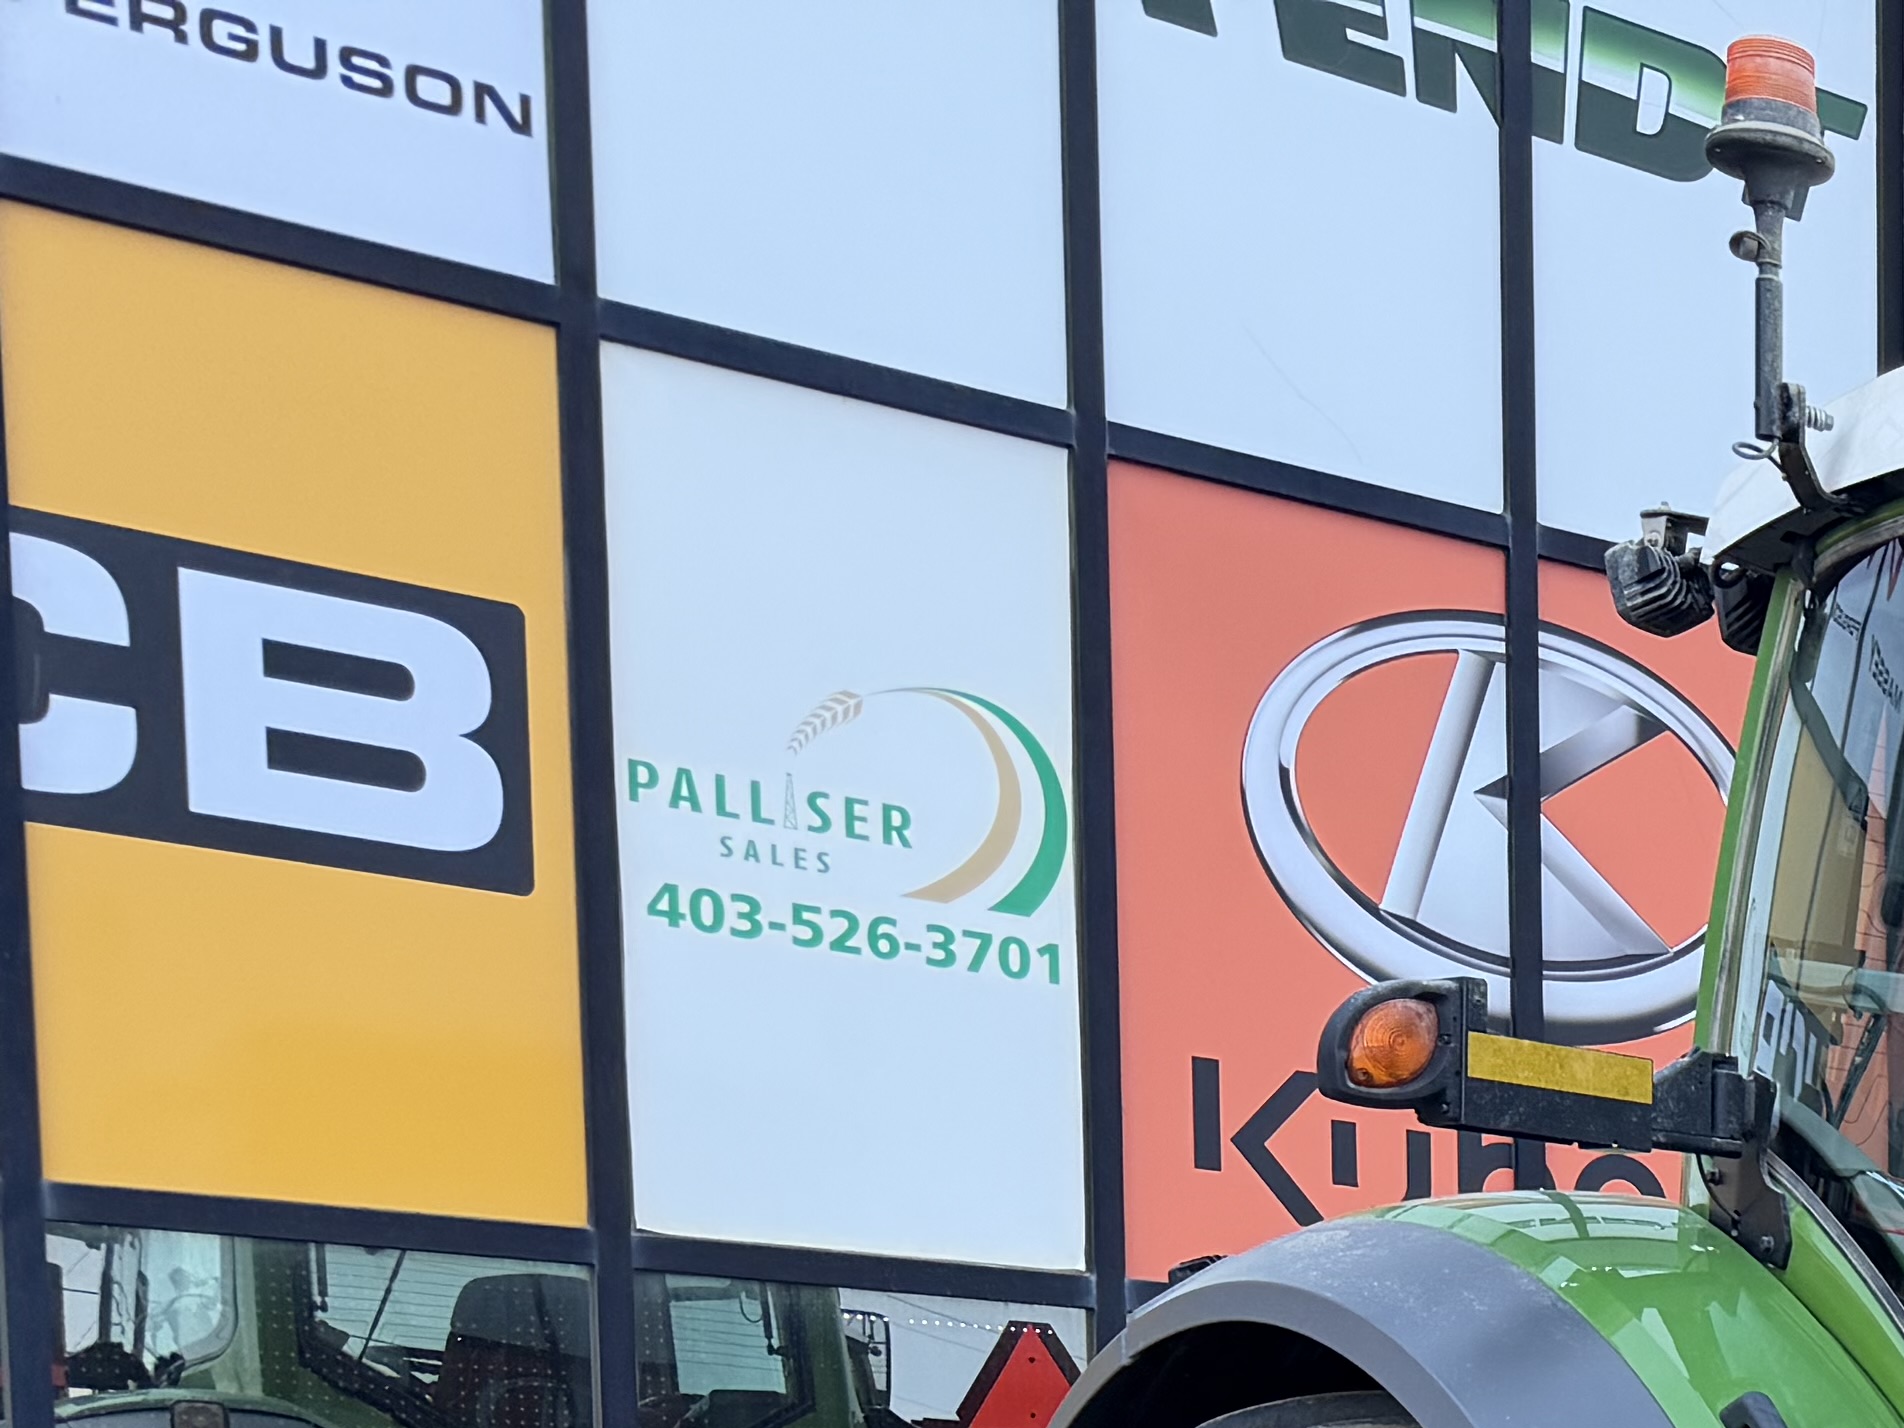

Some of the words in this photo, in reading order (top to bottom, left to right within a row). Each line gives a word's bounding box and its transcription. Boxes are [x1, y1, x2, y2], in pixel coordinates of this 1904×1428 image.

[627, 758, 914, 850] PALLISER
[719, 836, 832, 873] SALES
[646, 882, 1061, 985] 403-526-3701
